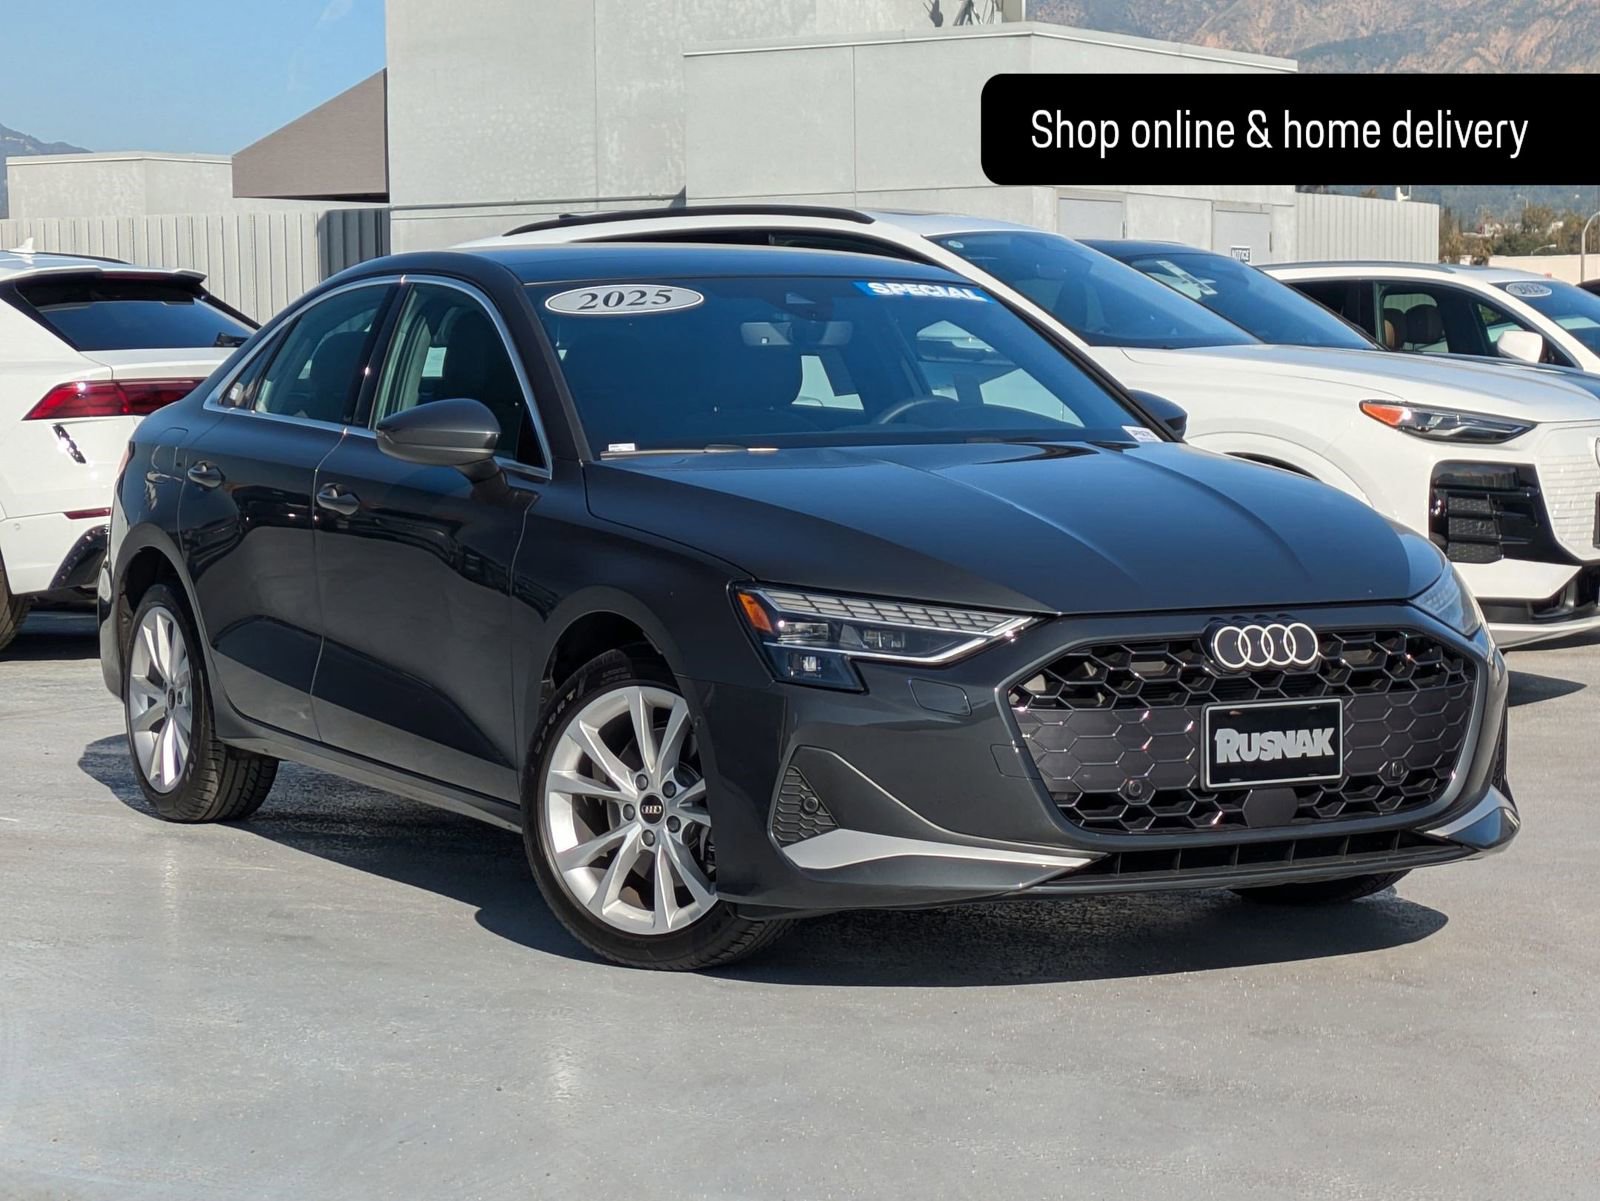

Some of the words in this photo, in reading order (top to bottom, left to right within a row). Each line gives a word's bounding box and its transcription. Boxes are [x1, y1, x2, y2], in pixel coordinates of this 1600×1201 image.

[577, 289, 673, 310] 2025
[867, 282, 988, 302] SPECIAL
[1214, 727, 1335, 764] RUSNAK
